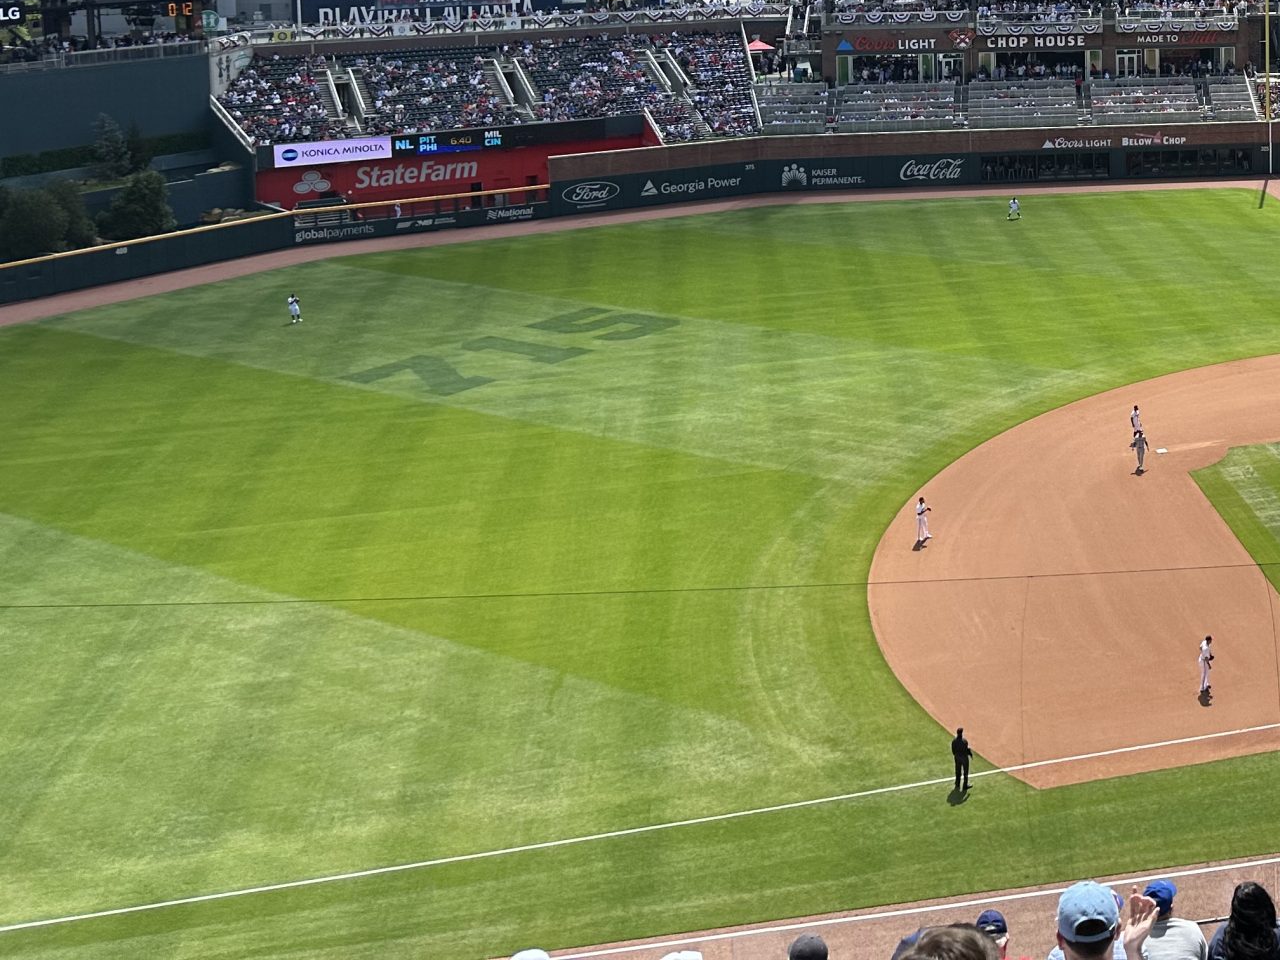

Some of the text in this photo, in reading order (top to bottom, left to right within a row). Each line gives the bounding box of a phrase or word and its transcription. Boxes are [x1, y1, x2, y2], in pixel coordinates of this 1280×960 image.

[898, 39, 936, 49] LIGHT
[987, 35, 1086, 48] CHOP HOUSE
[1137, 35, 1163, 43] MADE
[1166, 34, 1179, 42] TO
[419, 130, 502, 145] PIT 6:40 MIL
[1055, 137, 1112, 148] Coors LIGHT
[1122, 136, 1186, 146] BELOW CHOP
[396, 140, 414, 150] NL
[420, 138, 501, 152] PHI CIN
[302, 144, 385, 158] KONICA MINOLTA
[661, 177, 741, 194] Georgia Power
[812, 177, 861, 185] PERMANENTE
[572, 185, 609, 200] Ford
[497, 207, 534, 218] National
